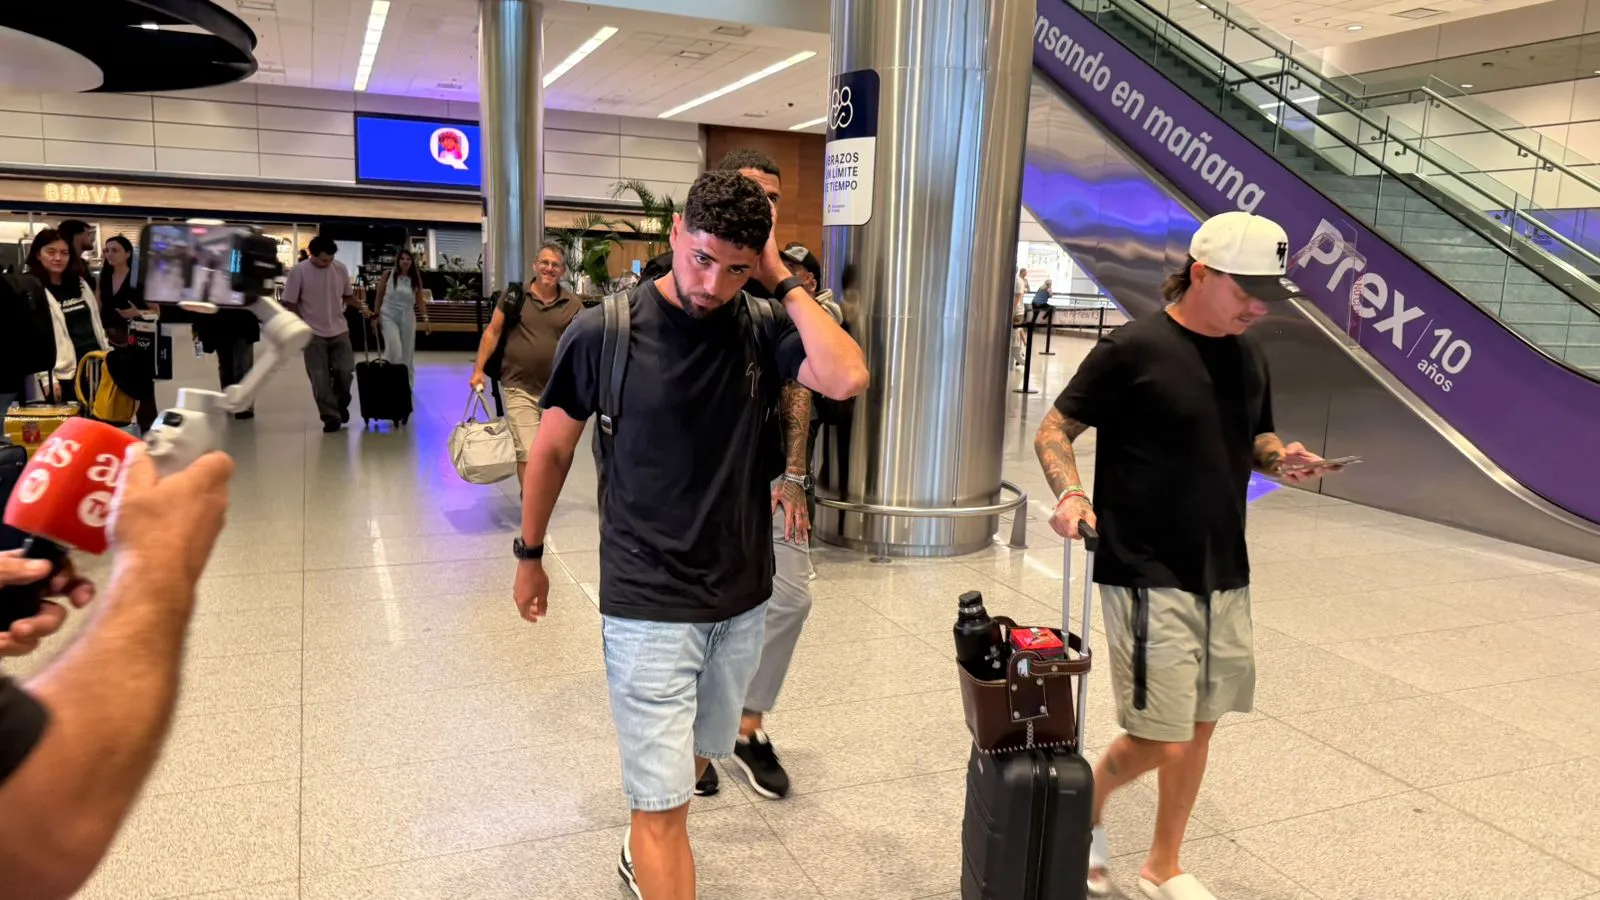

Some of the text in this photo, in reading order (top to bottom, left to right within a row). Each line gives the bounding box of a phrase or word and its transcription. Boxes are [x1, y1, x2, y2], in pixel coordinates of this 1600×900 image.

[1111, 80, 1146, 121] en
[1142, 105, 1266, 213] mañana
[44, 182, 121, 204] BRAVA
[1298, 217, 1426, 351] Prex
[1429, 328, 1473, 375] 10
[1416, 358, 1454, 393] años
